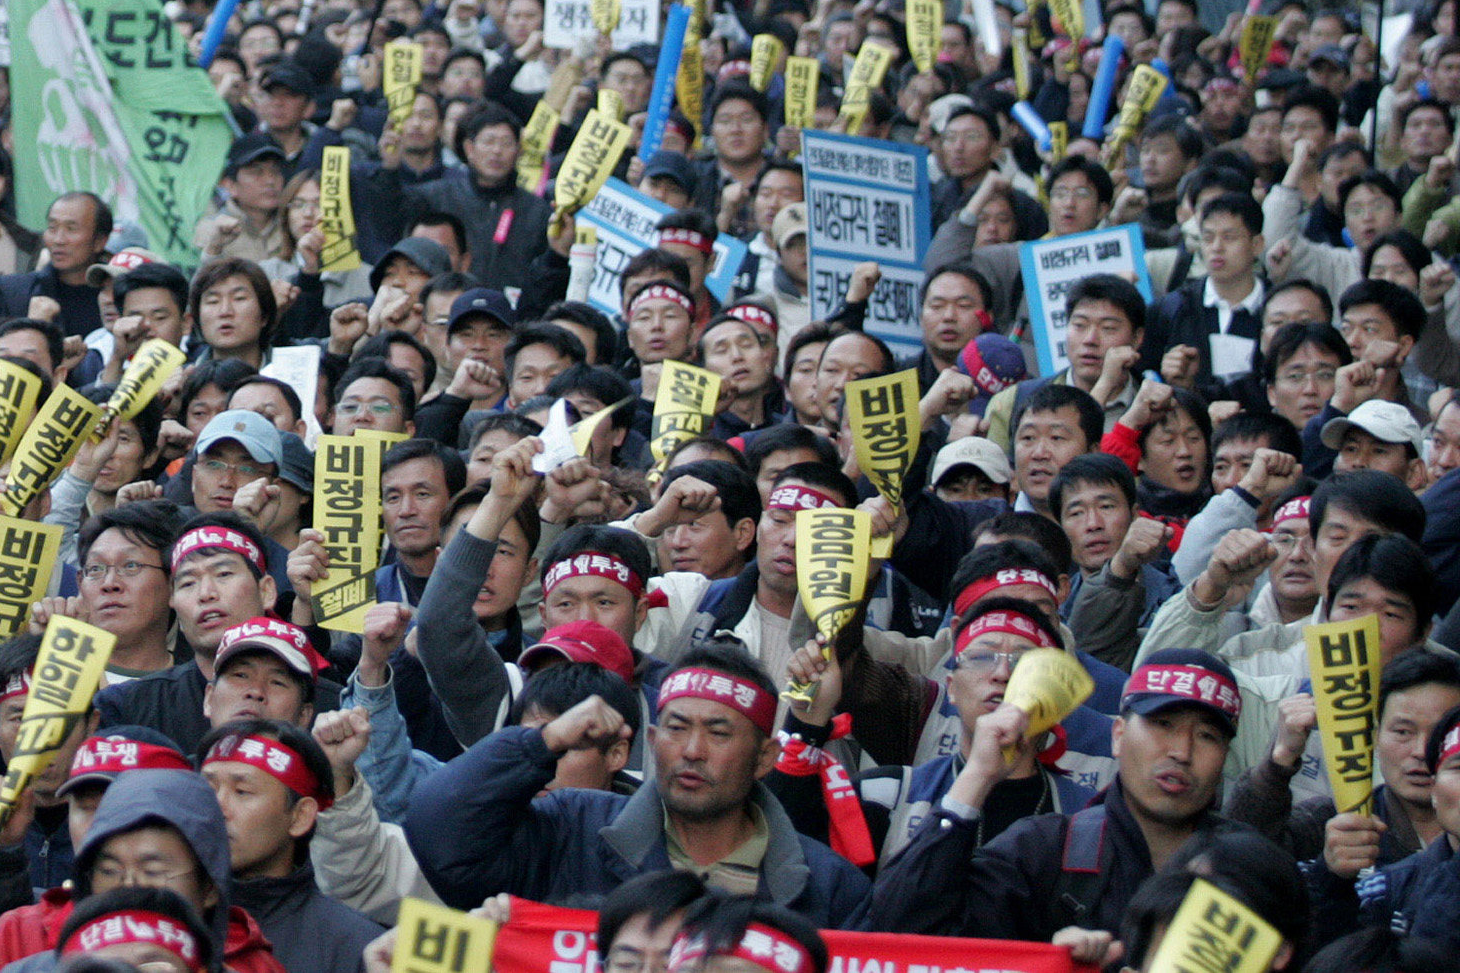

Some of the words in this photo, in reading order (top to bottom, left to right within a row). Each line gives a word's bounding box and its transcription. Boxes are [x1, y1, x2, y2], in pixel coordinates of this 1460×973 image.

[811, 188, 870, 245] 비정규직
[659, 414, 703, 434] FTA
[323, 444, 366, 577] 비정규직
[224, 531, 261, 563] 투쟁
[808, 513, 856, 601] 공무원
[543, 560, 574, 588] 단결
[589, 555, 630, 583] 투쟁
[995, 567, 1041, 584] 단결
[917, 604, 940, 619] Lee
[267, 619, 308, 649] 투쟁
[34, 628, 96, 710] 한일
[1146, 669, 1194, 695] 단결
[706, 674, 759, 709] 투쟁
[1318, 629, 1373, 785] 비정규직
[92, 741, 139, 766] 투쟁
[237, 737, 292, 773] 투쟁
[79, 915, 124, 951] 단결
[156, 920, 197, 958] 투쟁
[738, 925, 803, 972] 투쟁
